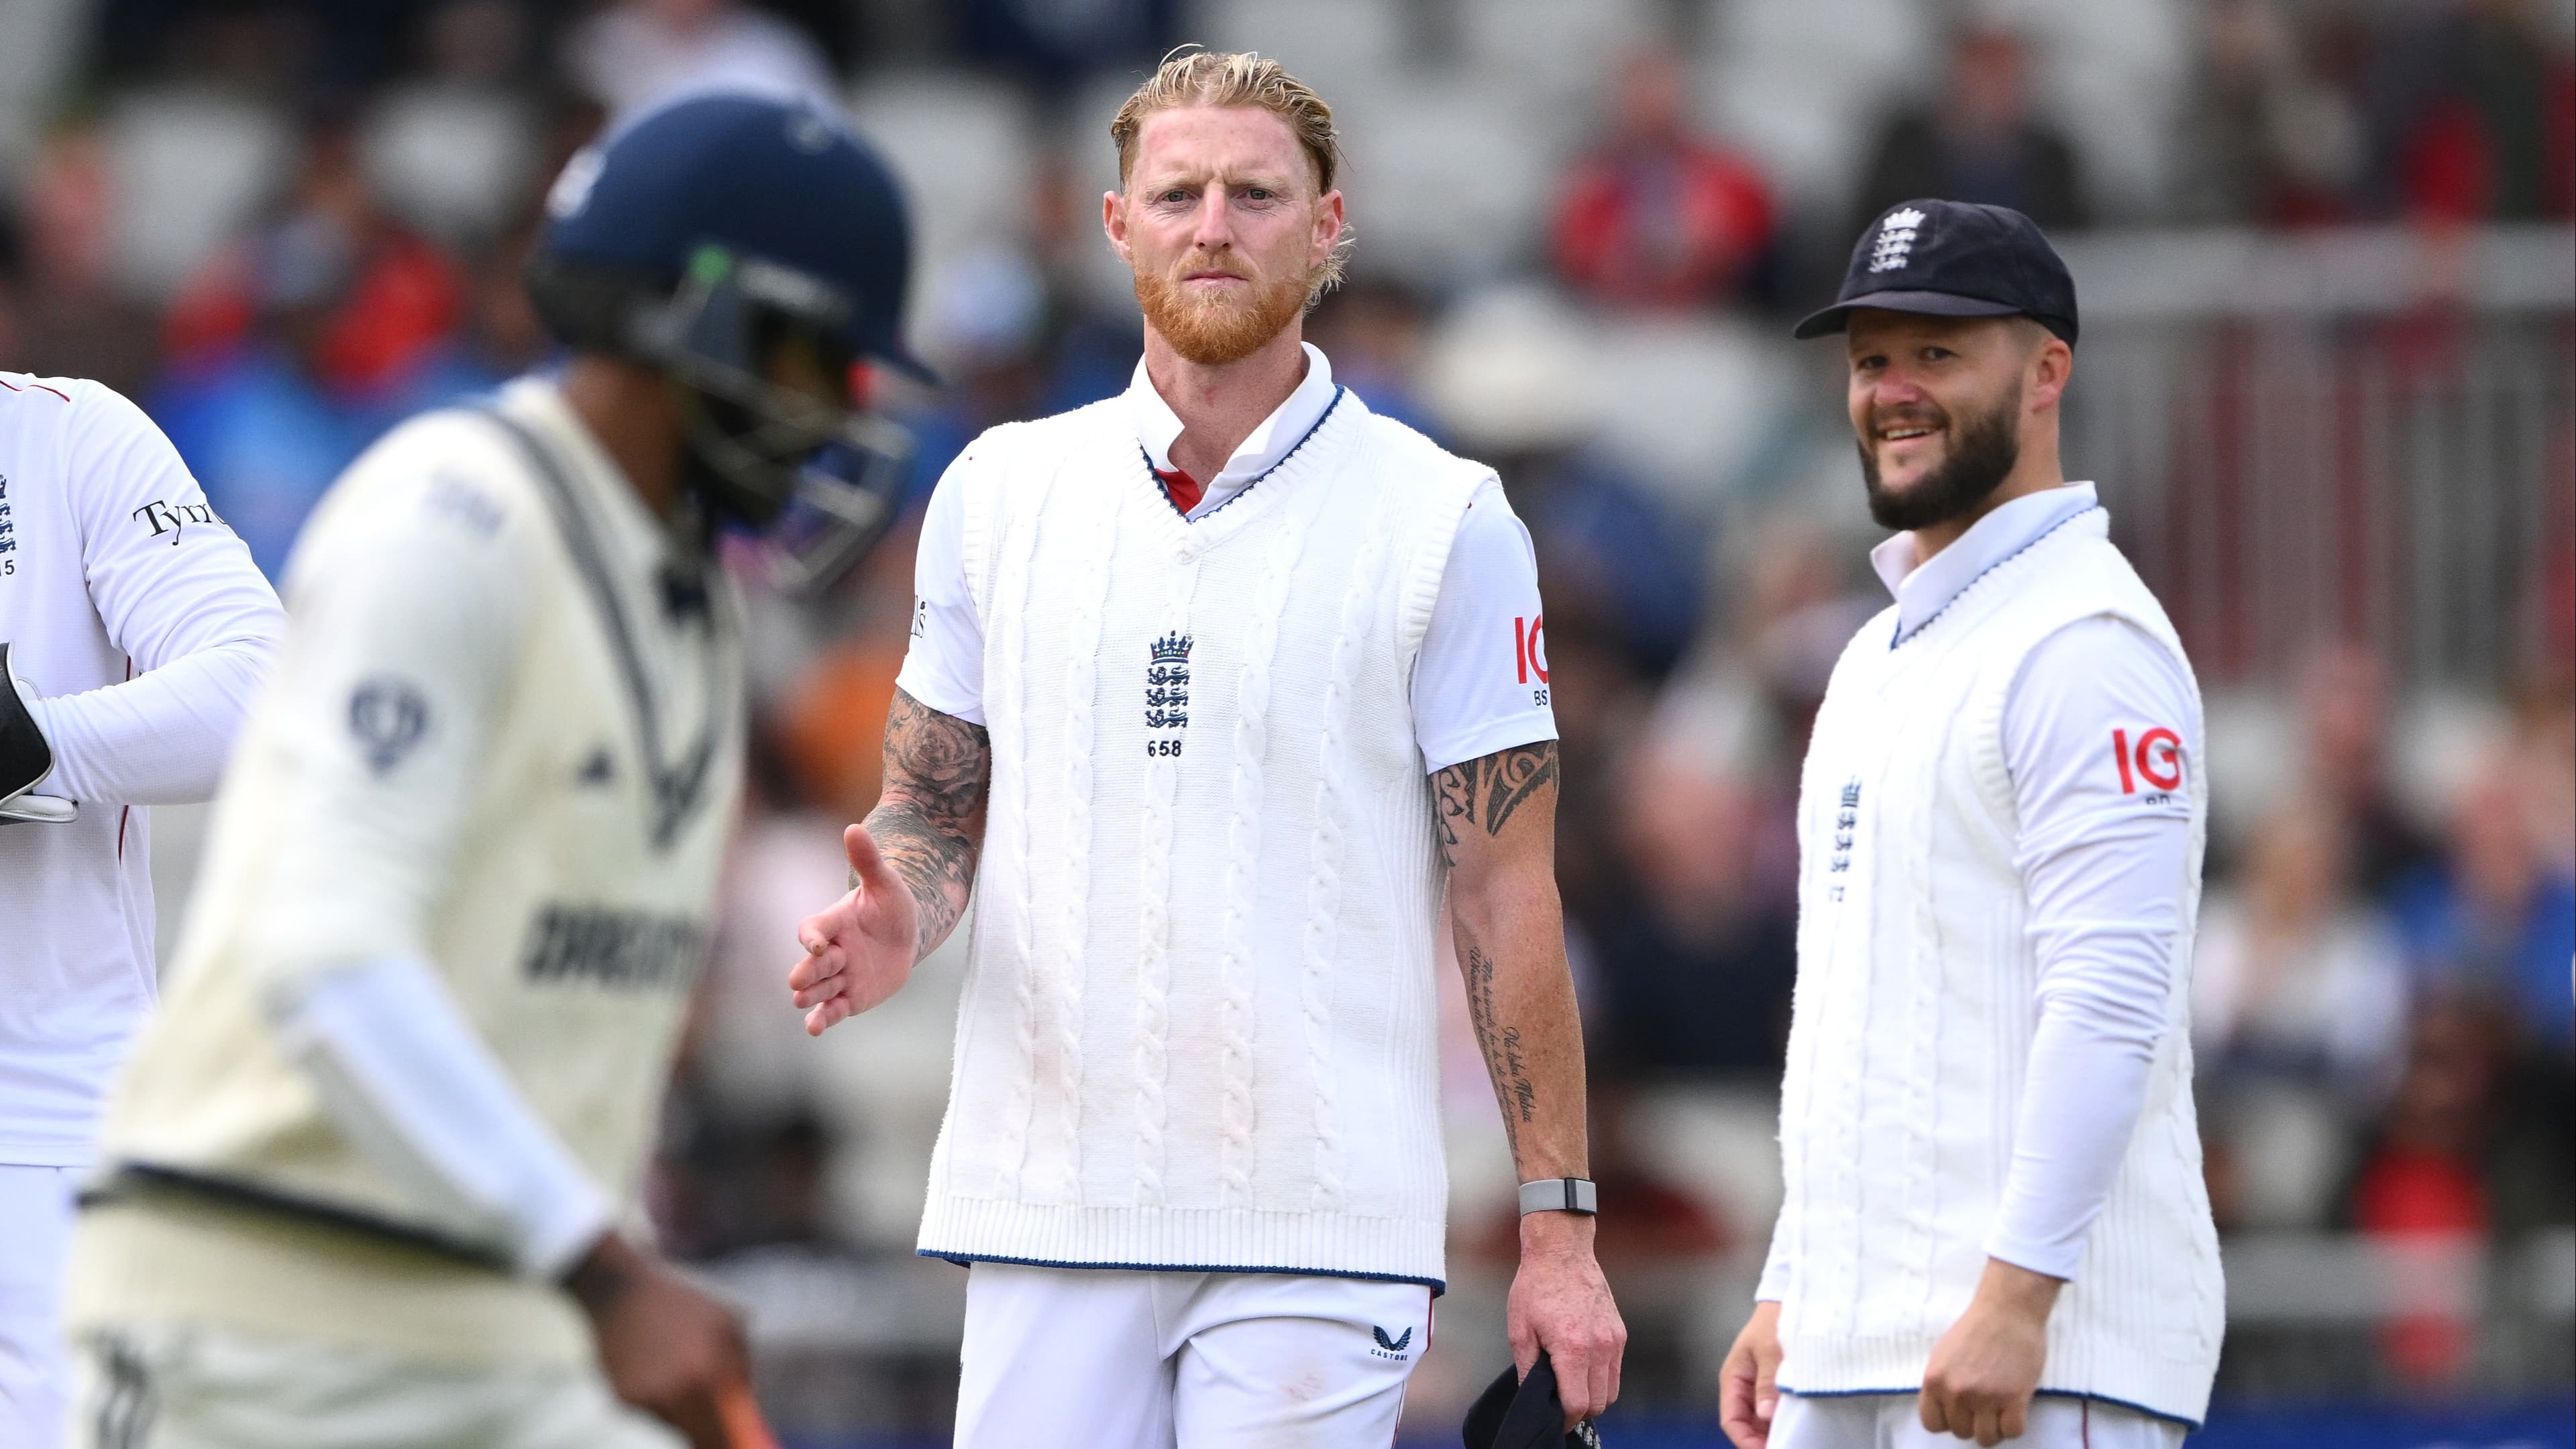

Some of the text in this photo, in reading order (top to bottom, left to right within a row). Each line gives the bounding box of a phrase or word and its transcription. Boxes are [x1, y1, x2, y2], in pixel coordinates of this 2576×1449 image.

[1534, 690, 1548, 706] BS
[1147, 740, 1181, 757] 658
[2113, 727, 2182, 794] IG
